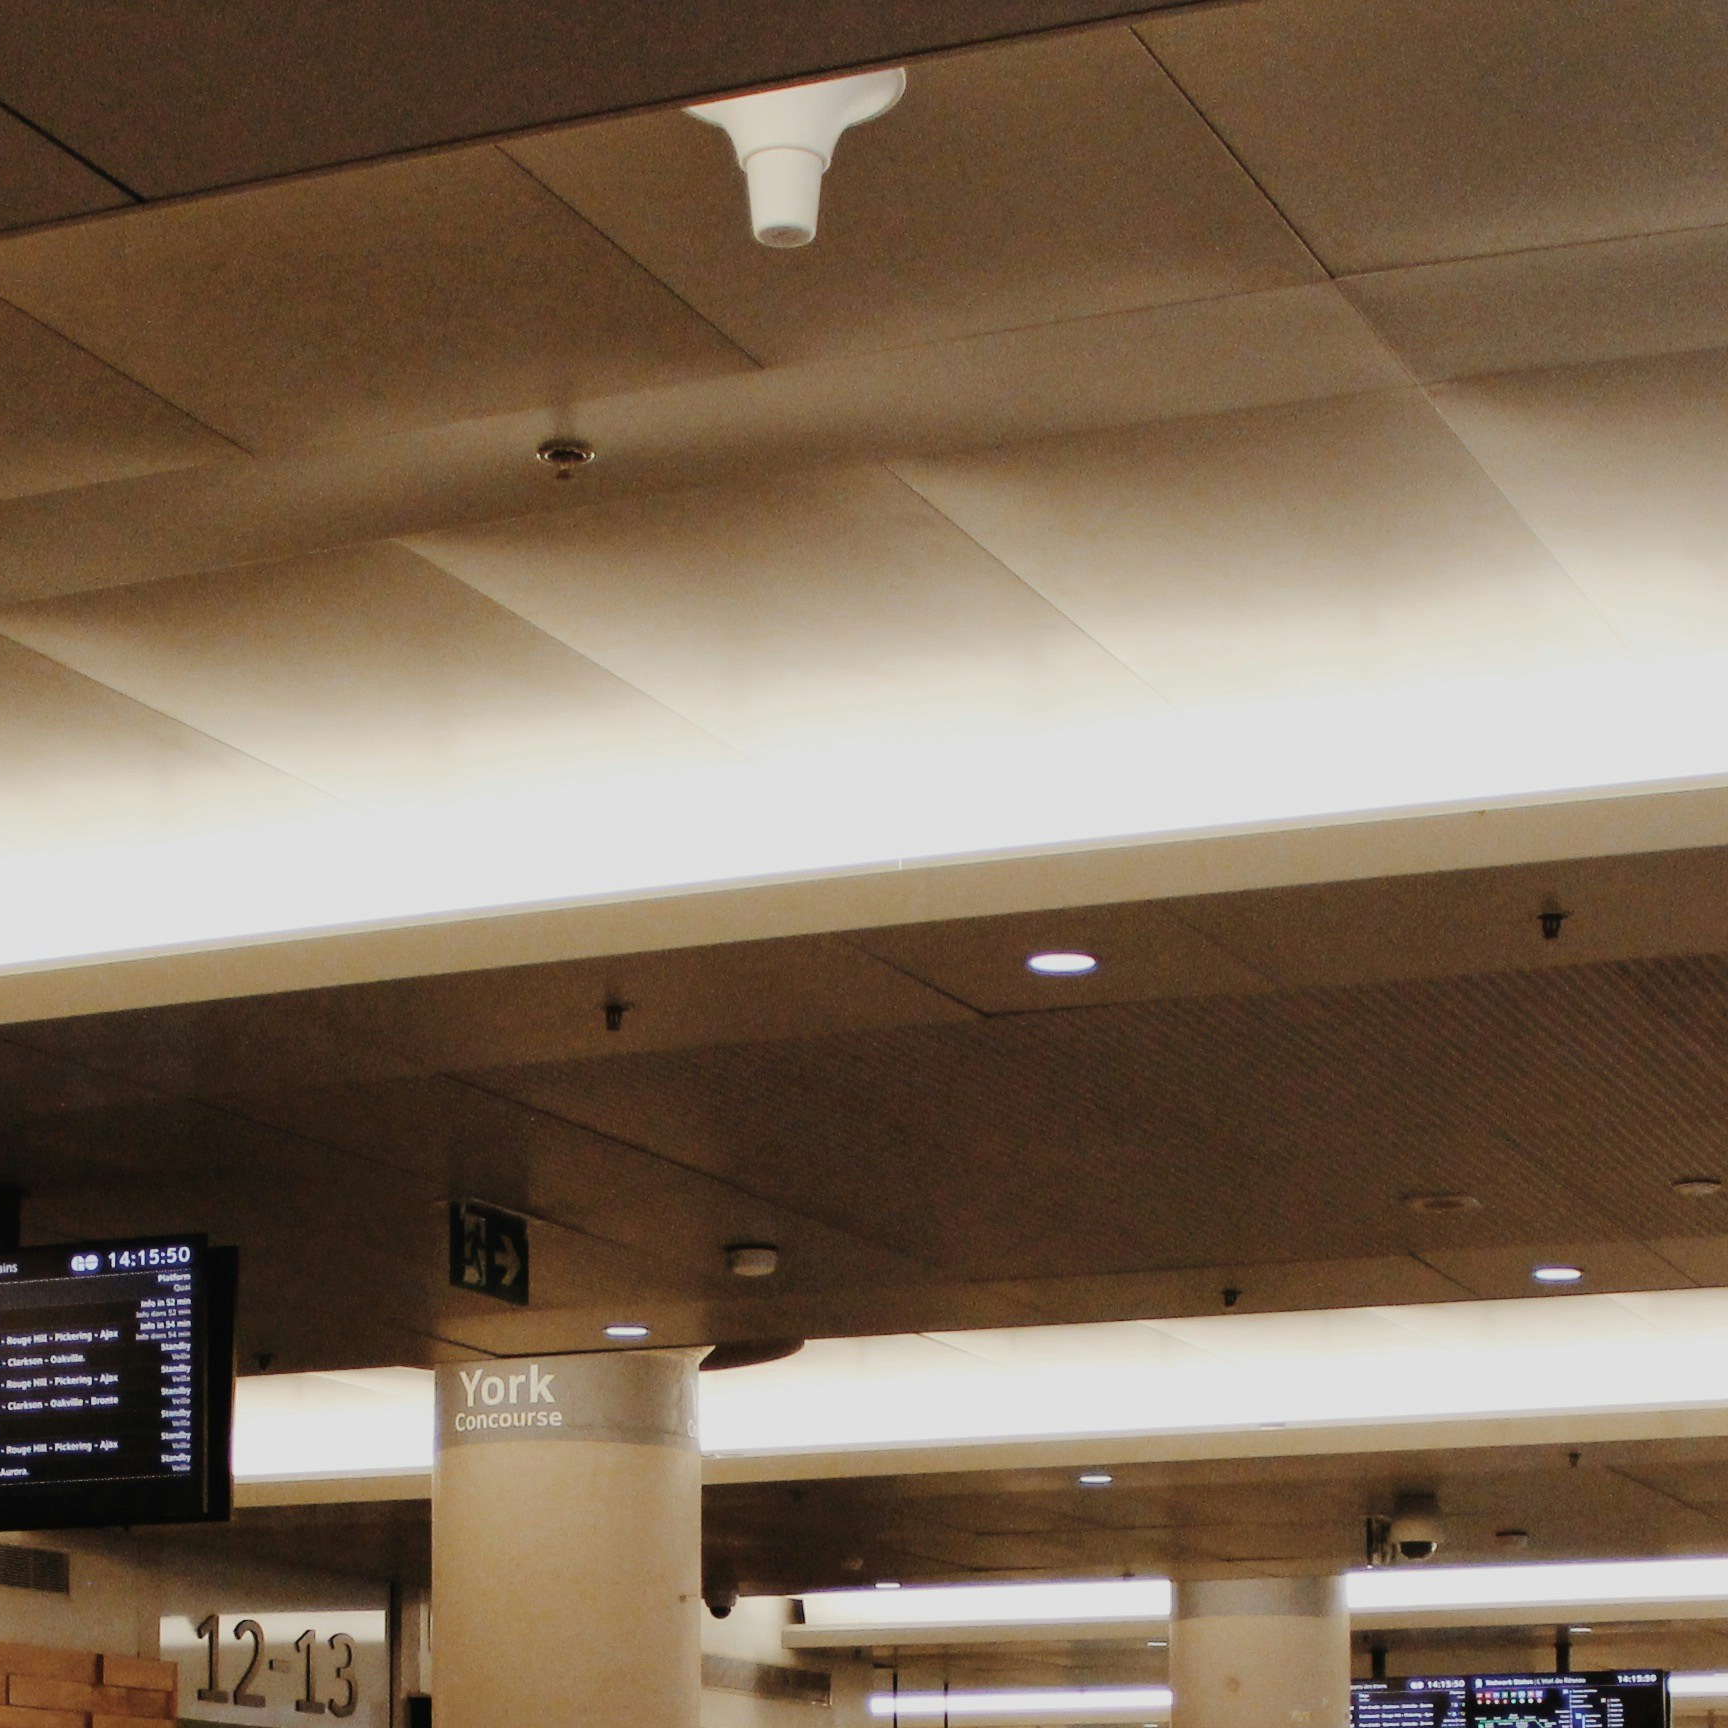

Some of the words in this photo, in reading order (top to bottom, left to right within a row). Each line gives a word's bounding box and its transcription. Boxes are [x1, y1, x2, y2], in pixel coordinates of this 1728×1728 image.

[108, 1246, 190, 1268] 14:15:50
[6, 1336, 32, 1347] Rouge
[55, 1331, 92, 1342] Pickering
[100, 1329, 118, 1340] Ajax
[8, 1356, 43, 1367] Clarkson
[459, 1363, 556, 1407] York
[455, 1411, 563, 1432] Concourse
[196, 1614, 358, 1718] 12-13
[1427, 1680, 1465, 1688] 14:15:50
[1617, 1674, 1657, 1683] 14:15:50
